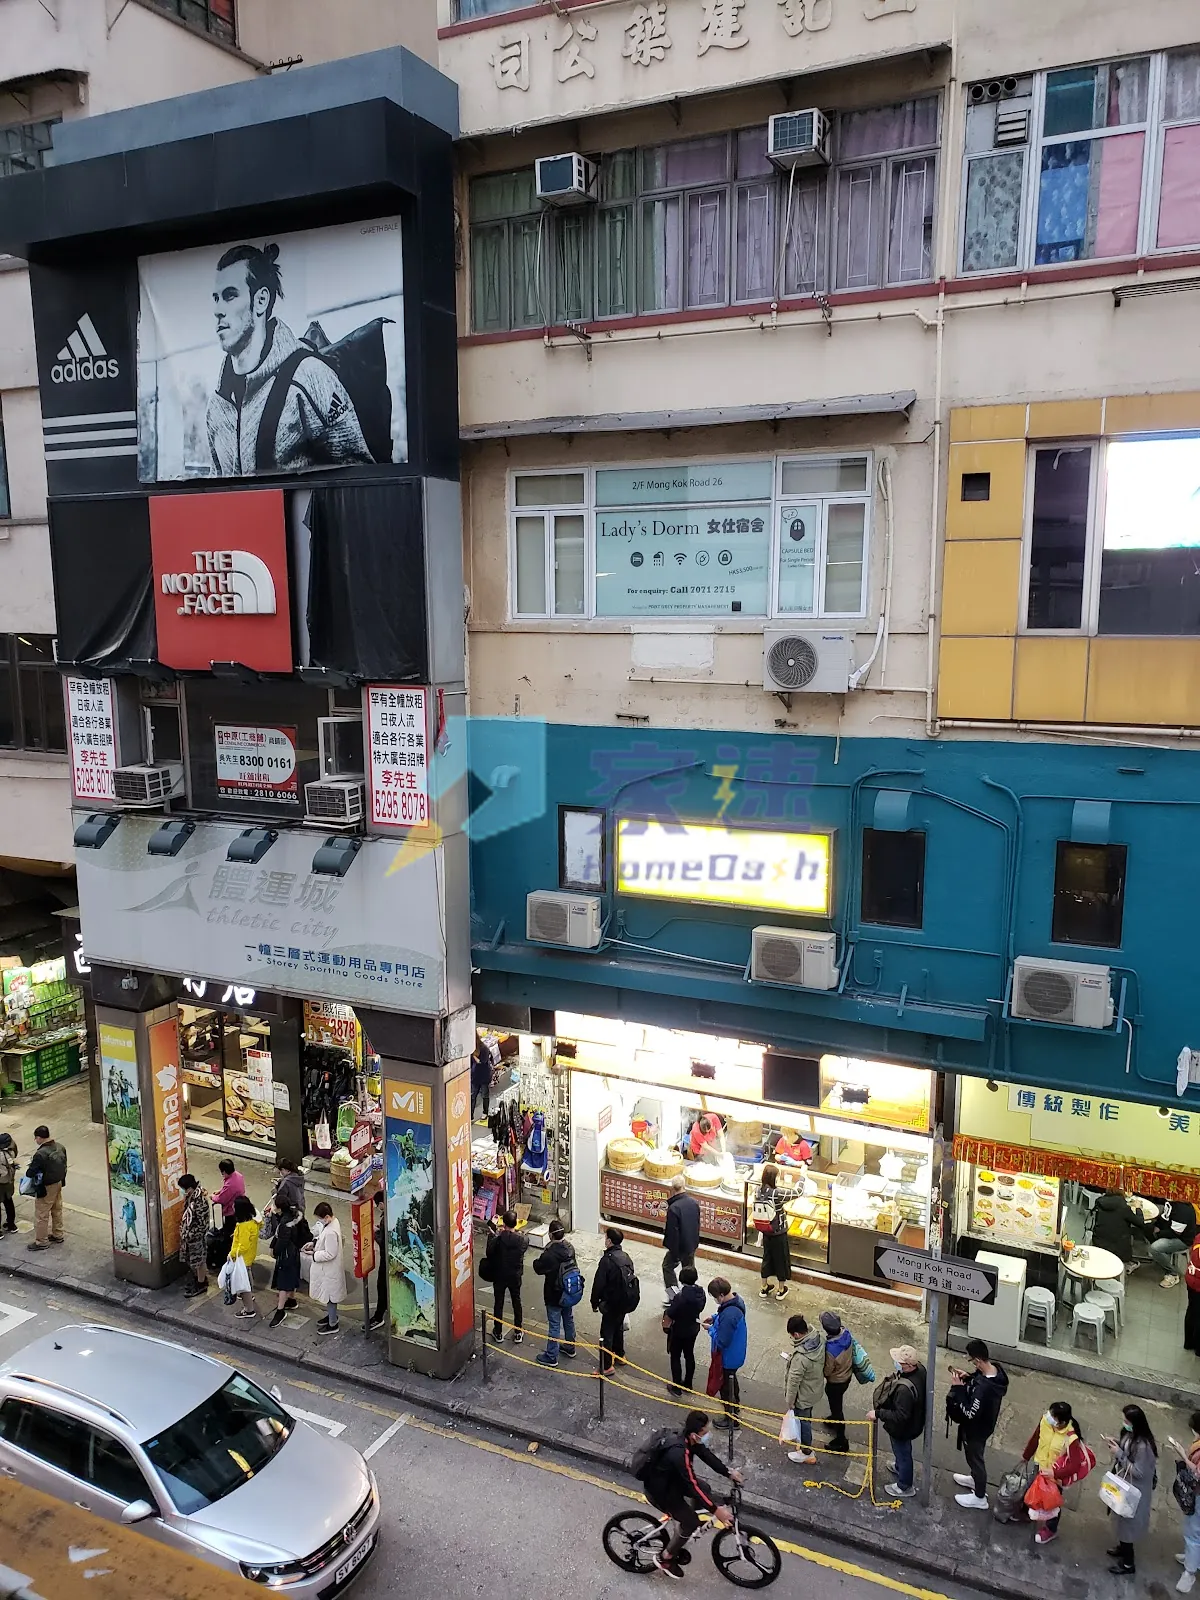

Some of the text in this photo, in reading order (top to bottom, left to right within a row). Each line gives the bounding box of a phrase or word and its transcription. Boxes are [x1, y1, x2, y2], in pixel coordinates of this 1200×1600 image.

[384, 222, 399, 232] BALE
[50, 356, 120, 384] adidas
[632, 477, 723, 491] 2/F Mong Kok Road 26
[601, 520, 648, 543] Lady's
[652, 520, 700, 536] Dorm
[192, 551, 233, 572] THE
[161, 572, 233, 594] NORTH
[670, 586, 688, 594] Call
[714, 585, 736, 593] 2715
[184, 593, 235, 615] FACE
[77, 699, 104, 712] 日夜人流
[380, 712, 415, 728] 日夜人流
[372, 731, 424, 748] 適合各行各業
[80, 750, 108, 766] 李先生
[239, 755, 264, 767] 8300
[267, 757, 291, 769] 0161
[373, 750, 425, 767] 特大廣告招牌
[76, 767, 95, 793] 5295
[381, 769, 417, 790] 李先生
[254, 789, 275, 798] 2810
[277, 791, 297, 800] 6066
[375, 789, 425, 821] 5295 8078
[208, 864, 344, 915] 體運城
[290, 917, 340, 948] city
[244, 943, 426, 980] 一幢三層式運動用品專門店
[247, 954, 252, 962] 3
[266, 957, 299, 970] Storey
[303, 963, 348, 977] Sporting
[354, 971, 389, 983] Goods
[393, 977, 423, 988] Store
[1017, 1089, 1120, 1121] 傳統製作
[161, 1093, 184, 1210] Lafuma
[896, 1255, 972, 1280] Mong Kok Road
[913, 1272, 953, 1291] 旺角道
[956, 1284, 981, 1295] 30-44
[338, 1562, 350, 1580] SV
